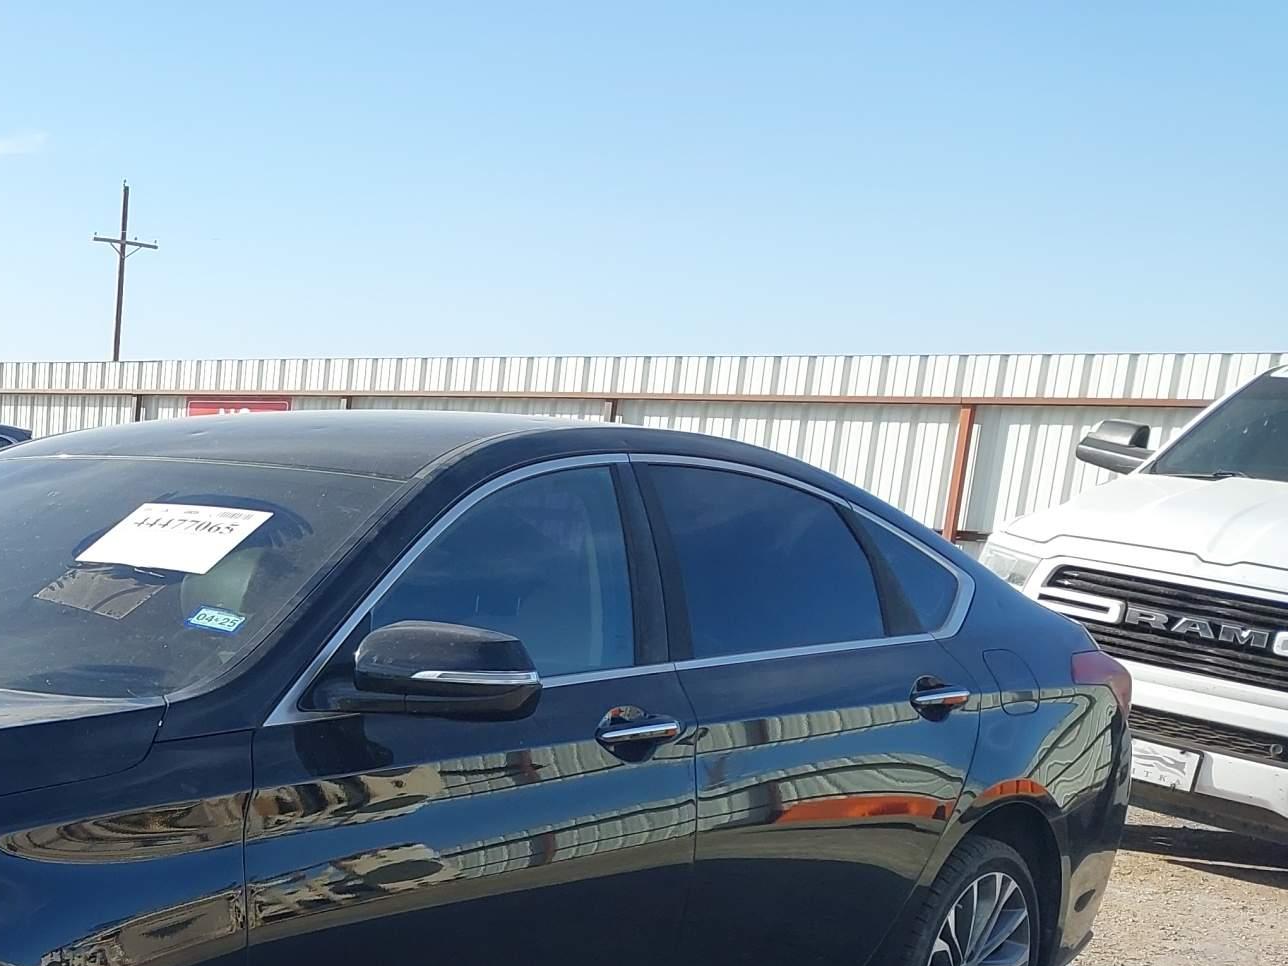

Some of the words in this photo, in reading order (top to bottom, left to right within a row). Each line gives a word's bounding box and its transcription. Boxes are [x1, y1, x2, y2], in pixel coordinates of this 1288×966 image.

[134, 516, 241, 535] 44477065
[1124, 606, 1270, 649] RAM
[1132, 767, 1181, 786] ITKA
